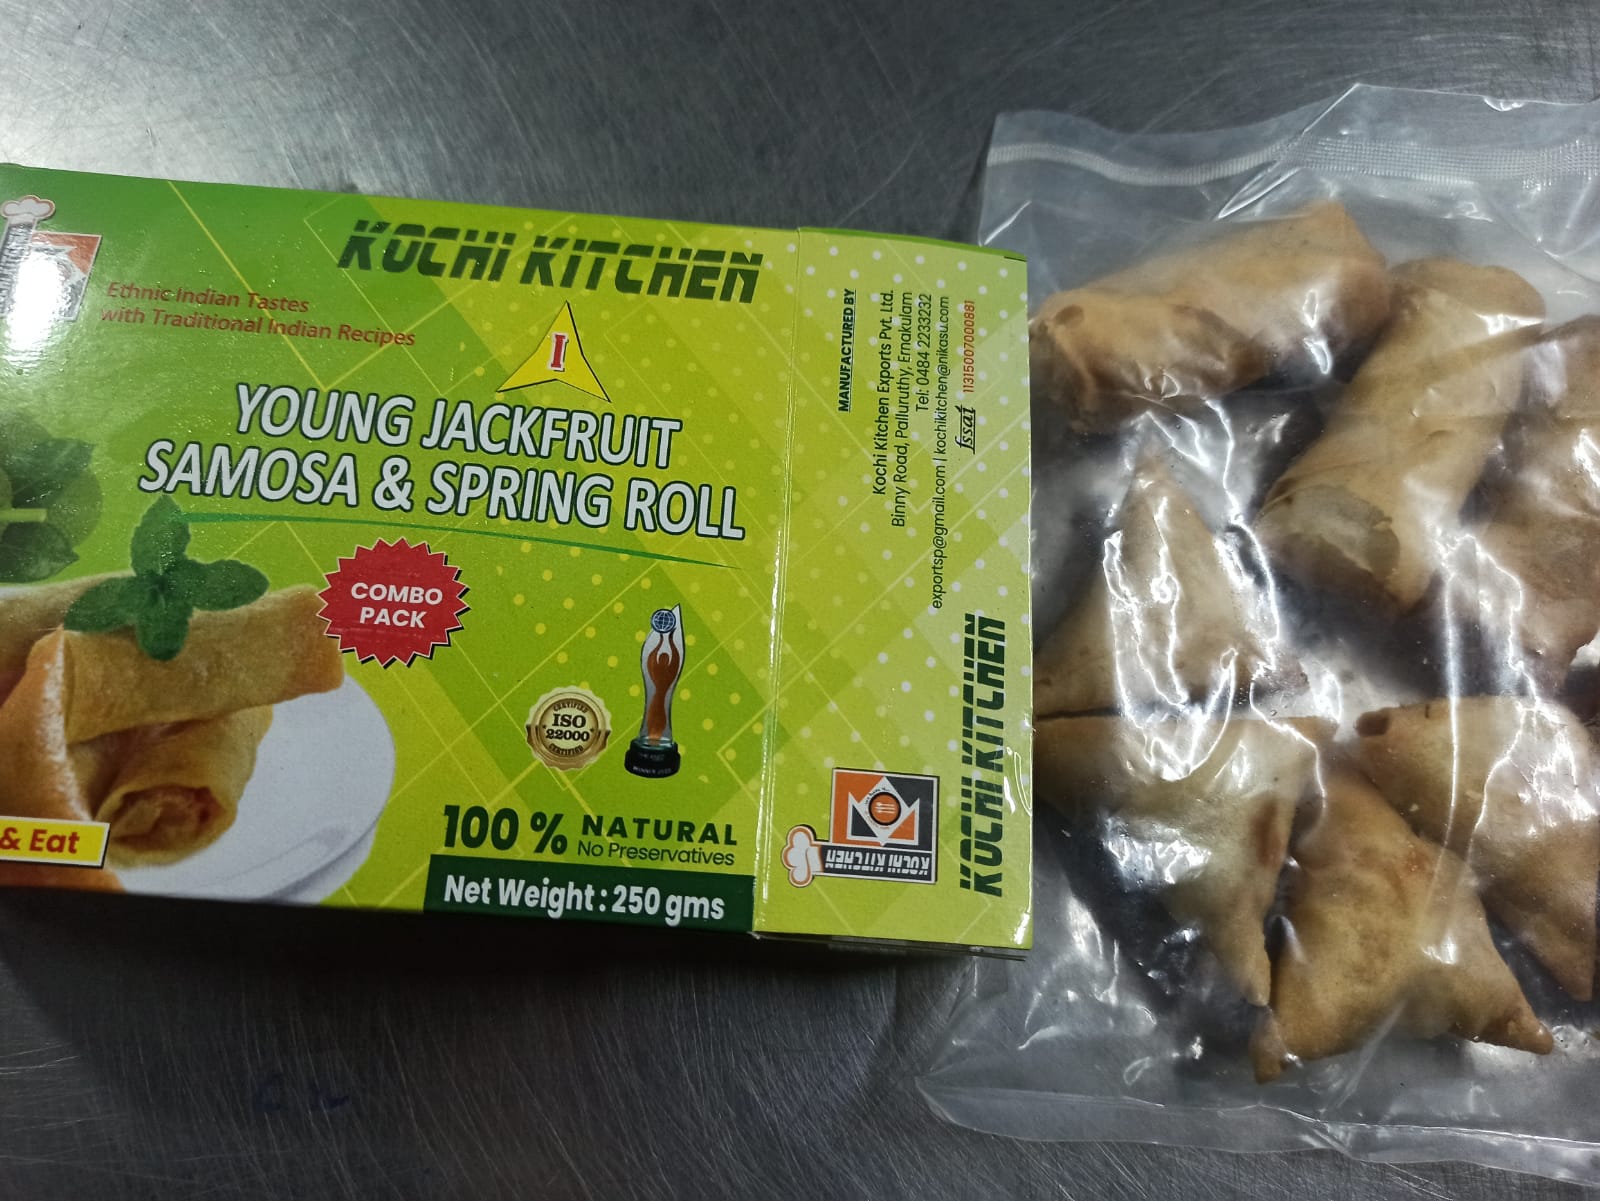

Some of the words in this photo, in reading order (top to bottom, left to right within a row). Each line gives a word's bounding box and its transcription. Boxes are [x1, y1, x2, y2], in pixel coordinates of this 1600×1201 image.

[338, 219, 516, 282] KOCHI
[520, 235, 764, 304] KITCHEN
[107, 281, 171, 303] Ethnic
[176, 288, 239, 308] Indian
[247, 293, 310, 313] Tastes
[843, 288, 855, 305] BY
[879, 290, 894, 313] Ltd.
[100, 307, 145, 324] with
[151, 309, 262, 334] Traditional
[268, 319, 332, 340] Indian
[338, 325, 416, 349] Recipes
[878, 316, 892, 339] Pvt.
[897, 292, 913, 363] Ernakulam
[917, 293, 932, 348] 2233232
[838, 308, 853, 412] MANUFACTURED
[963, 300, 975, 393] 11315007000881
[877, 343, 896, 393] Exports
[916, 351, 931, 385] 0484
[933, 296, 950, 454] kochikitchen@nikasu.com
[895, 366, 914, 439] Palluruthy,
[915, 389, 930, 412] Tel:
[235, 382, 415, 446] YOUNG
[420, 400, 683, 469] JACKFRUIT
[874, 398, 889, 451] Kitchen
[872, 454, 888, 495] Kochi
[893, 442, 910, 483] Road,
[138, 438, 360, 508] SAMOSA
[375, 457, 413, 513] &
[425, 460, 614, 529] SPRING
[626, 479, 746, 541] ROLL
[891, 486, 910, 527] Binny
[930, 465, 947, 609] exportsp@gmail.com
[350, 582, 443, 606] COMBO
[358, 606, 427, 629] PACK
[962, 613, 1006, 773] KITCHEN
[545, 728, 590, 742] 22000
[552, 713, 586, 728] ISO
[0, 827, 20, 850] &
[29, 828, 80, 854] Eat
[443, 804, 519, 850] 100
[530, 811, 568, 855] %
[581, 815, 738, 846] NATURAL
[960, 776, 1003, 897] KOCHI
[577, 841, 604, 857] No
[608, 843, 735, 866] Preservatives
[825, 848, 885, 873] KITCHEN
[888, 853, 930, 876] KOCHI
[444, 875, 491, 905] Net
[664, 892, 725, 926] gms
